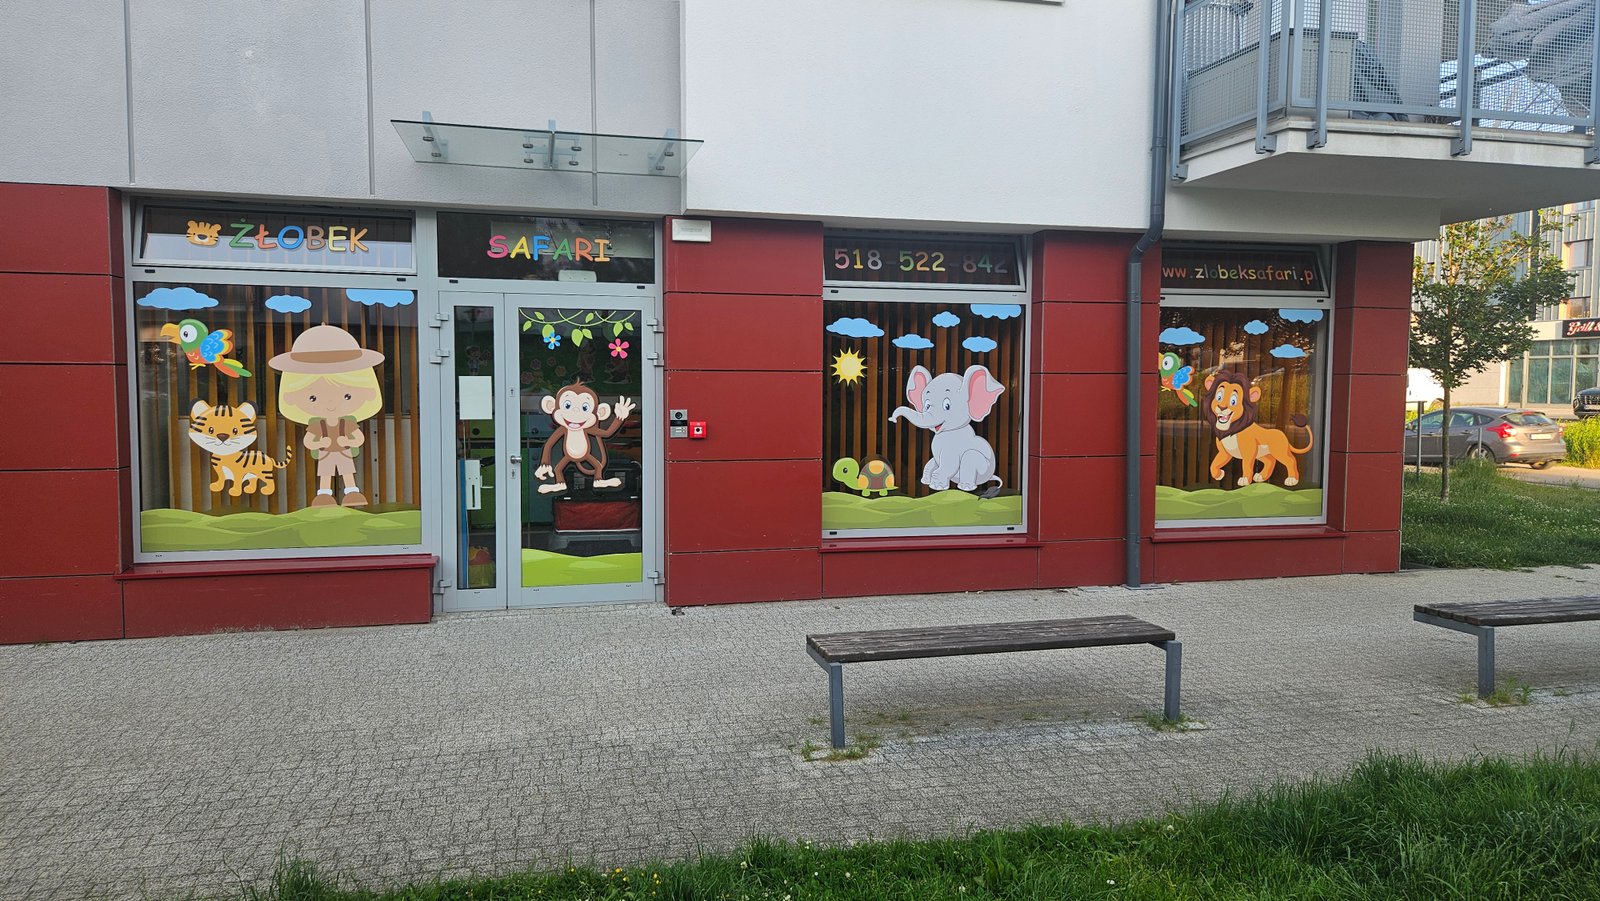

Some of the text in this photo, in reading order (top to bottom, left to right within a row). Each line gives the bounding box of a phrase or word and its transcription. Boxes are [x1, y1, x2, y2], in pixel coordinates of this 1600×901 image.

[228, 217, 369, 253] ŻŁOBEK
[486, 234, 611, 263] SAFARI
[1567, 321, 1594, 336] Grill
